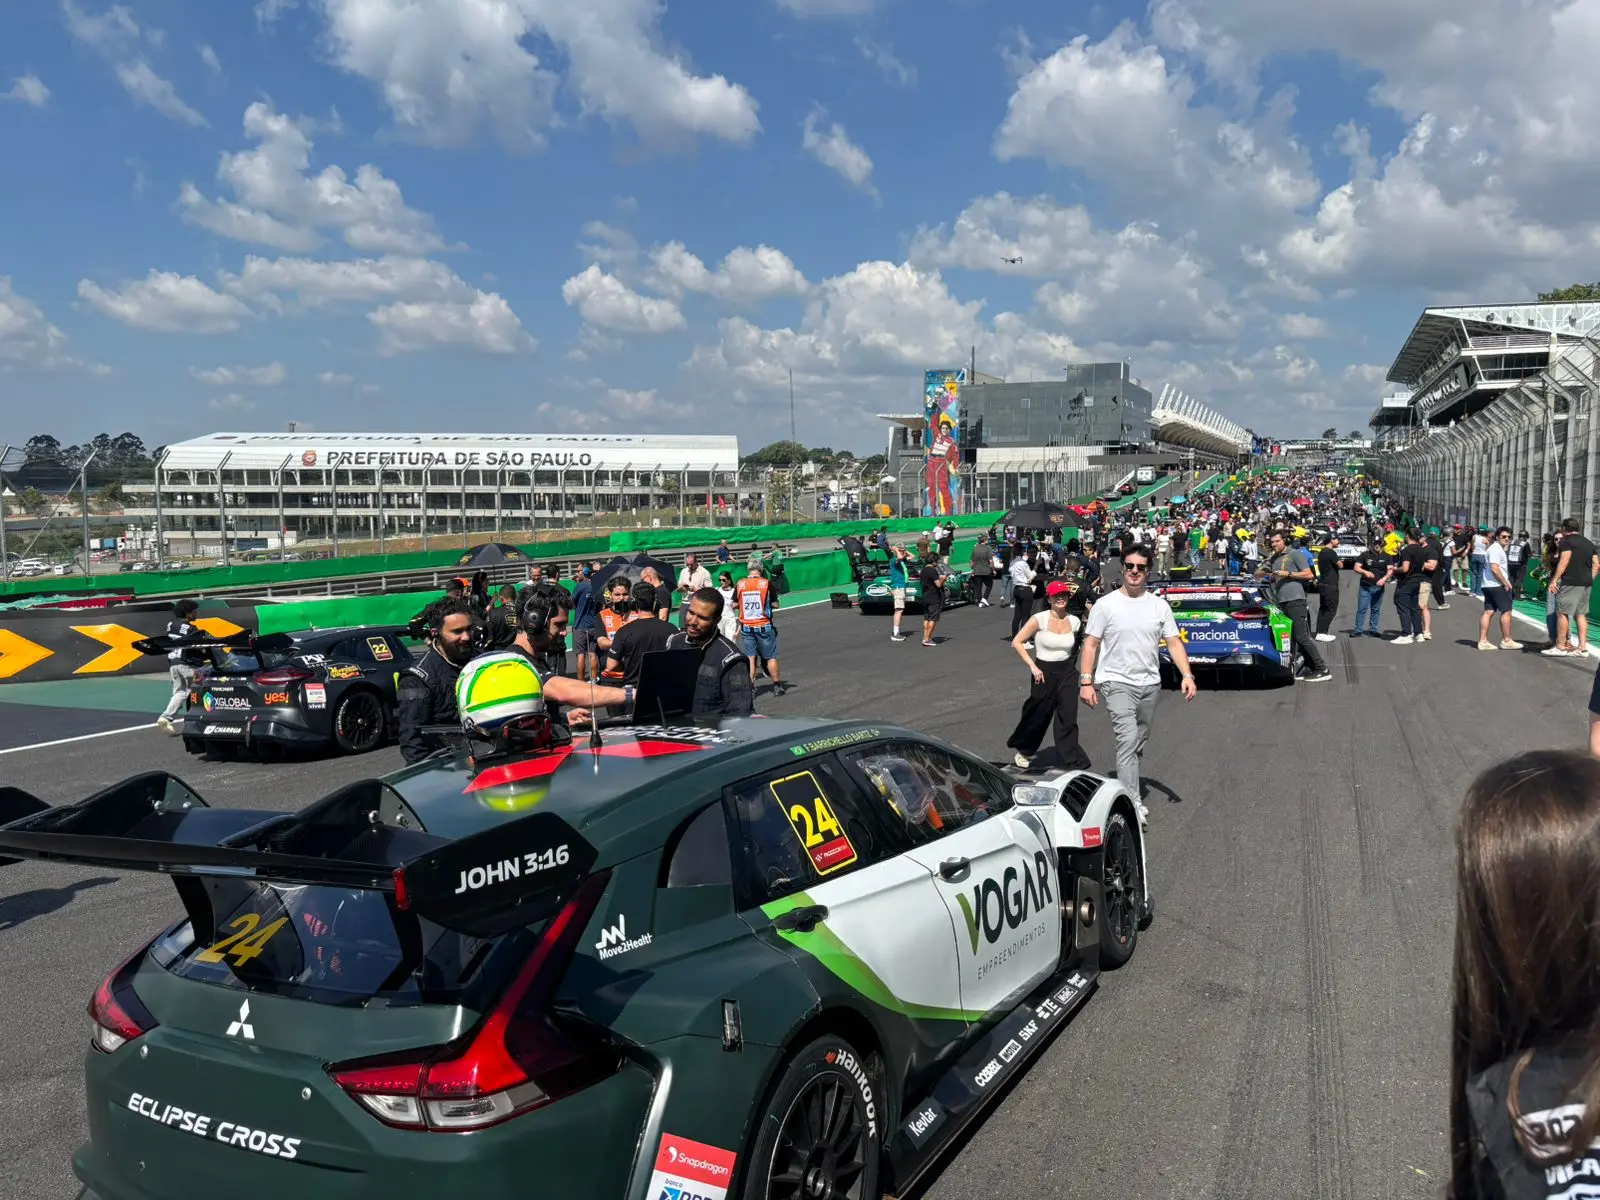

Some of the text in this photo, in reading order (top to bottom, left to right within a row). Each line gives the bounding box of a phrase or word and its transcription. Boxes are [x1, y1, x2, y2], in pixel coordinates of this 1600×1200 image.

[327, 450, 592, 466] PREFEITURA DE SÃO PAULO
[744, 602, 761, 610] 270
[1191, 629, 1240, 641] nacional
[373, 644, 388, 653] 22
[1188, 656, 1217, 664] Delco
[214, 697, 252, 708] XGLOBAL
[264, 692, 289, 705] yes!
[790, 797, 840, 848] 24
[455, 844, 570, 894] JOHN 3:16
[955, 850, 1053, 957] VOGAR
[195, 913, 289, 967] 24
[977, 922, 1046, 981] EMPREENDIMENTOS
[1018, 1019, 1039, 1041] SKF
[1001, 1041, 1020, 1060] MOTUL
[127, 1092, 301, 1159] ECLIPSE CROSS
[908, 1106, 938, 1137] Kevlar
[678, 1152, 729, 1175] Snapdragon
[664, 1178, 684, 1188] banco
